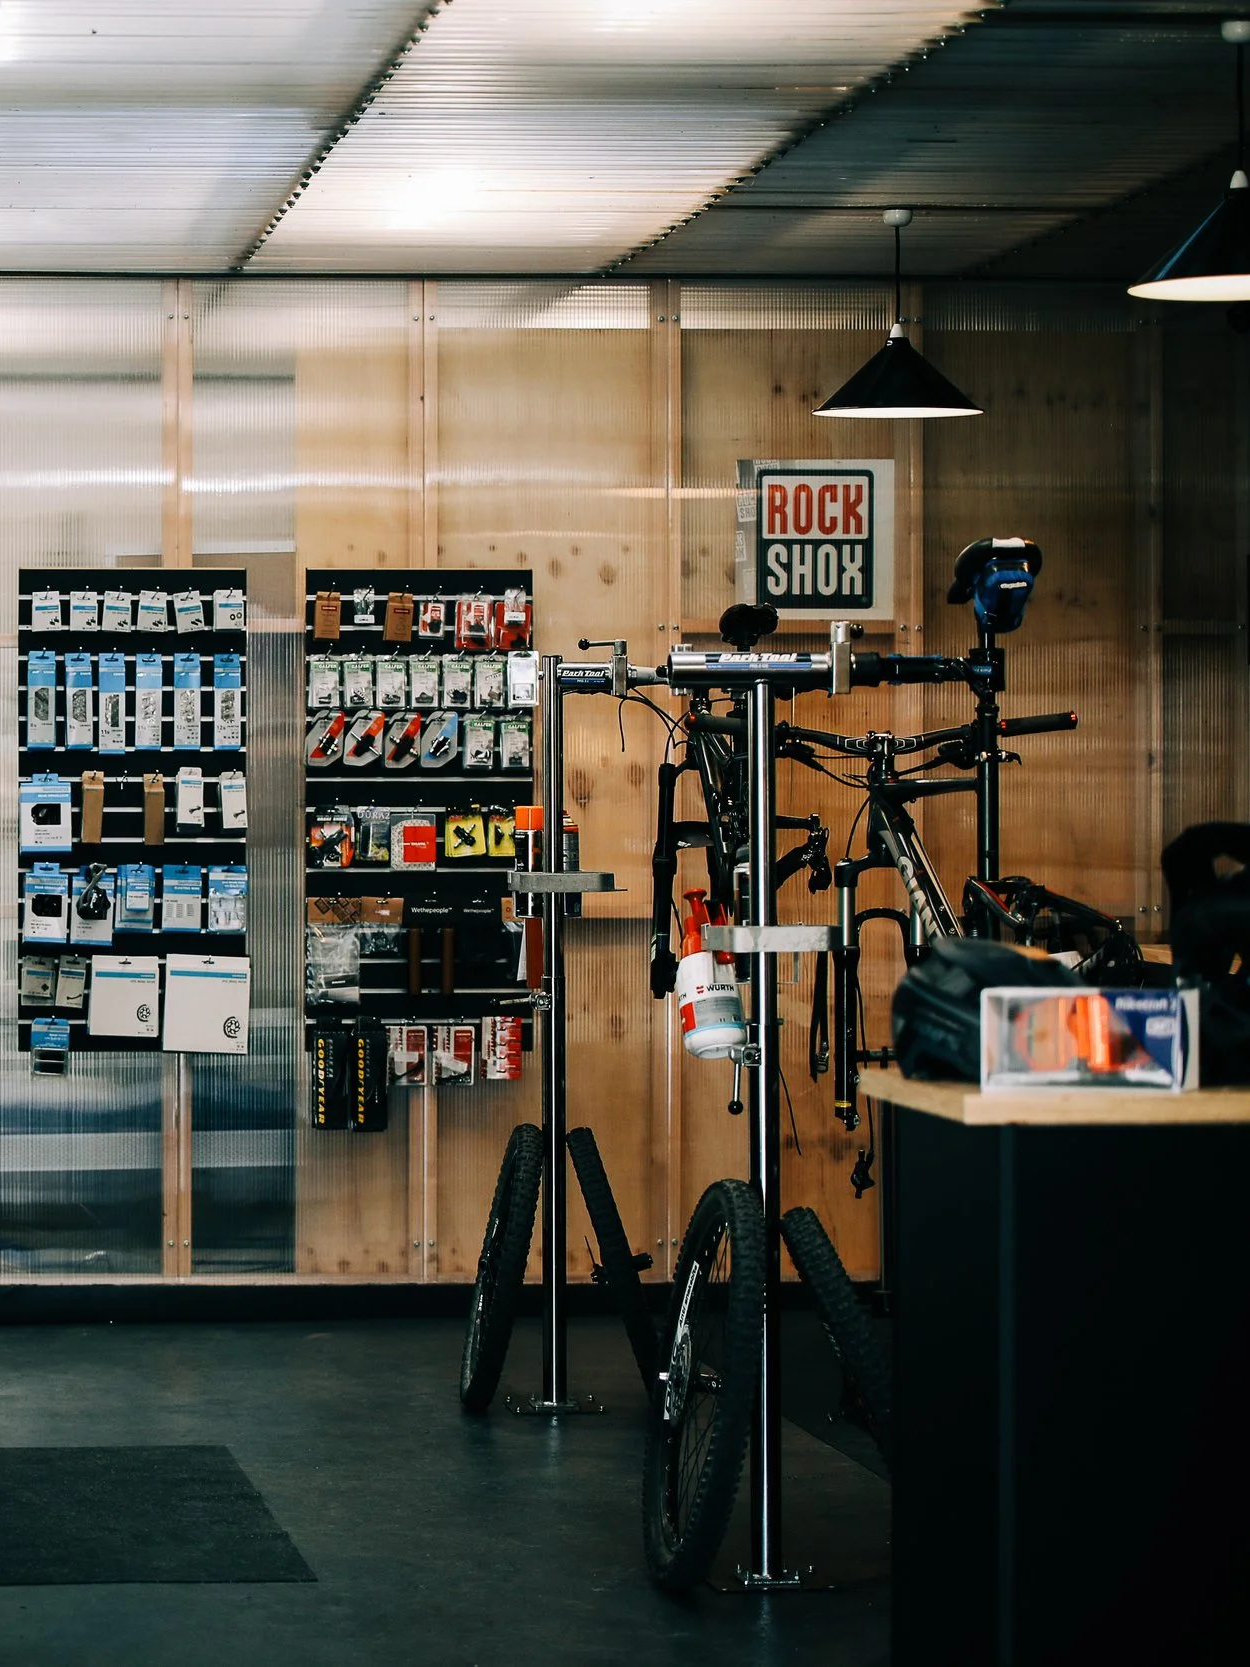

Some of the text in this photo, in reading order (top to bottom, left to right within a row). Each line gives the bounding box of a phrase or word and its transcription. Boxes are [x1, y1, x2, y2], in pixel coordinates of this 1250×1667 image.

[767, 483, 863, 536] ROCK
[766, 543, 863, 596] SHOX
[357, 1038, 365, 1124] GOODYEAR
